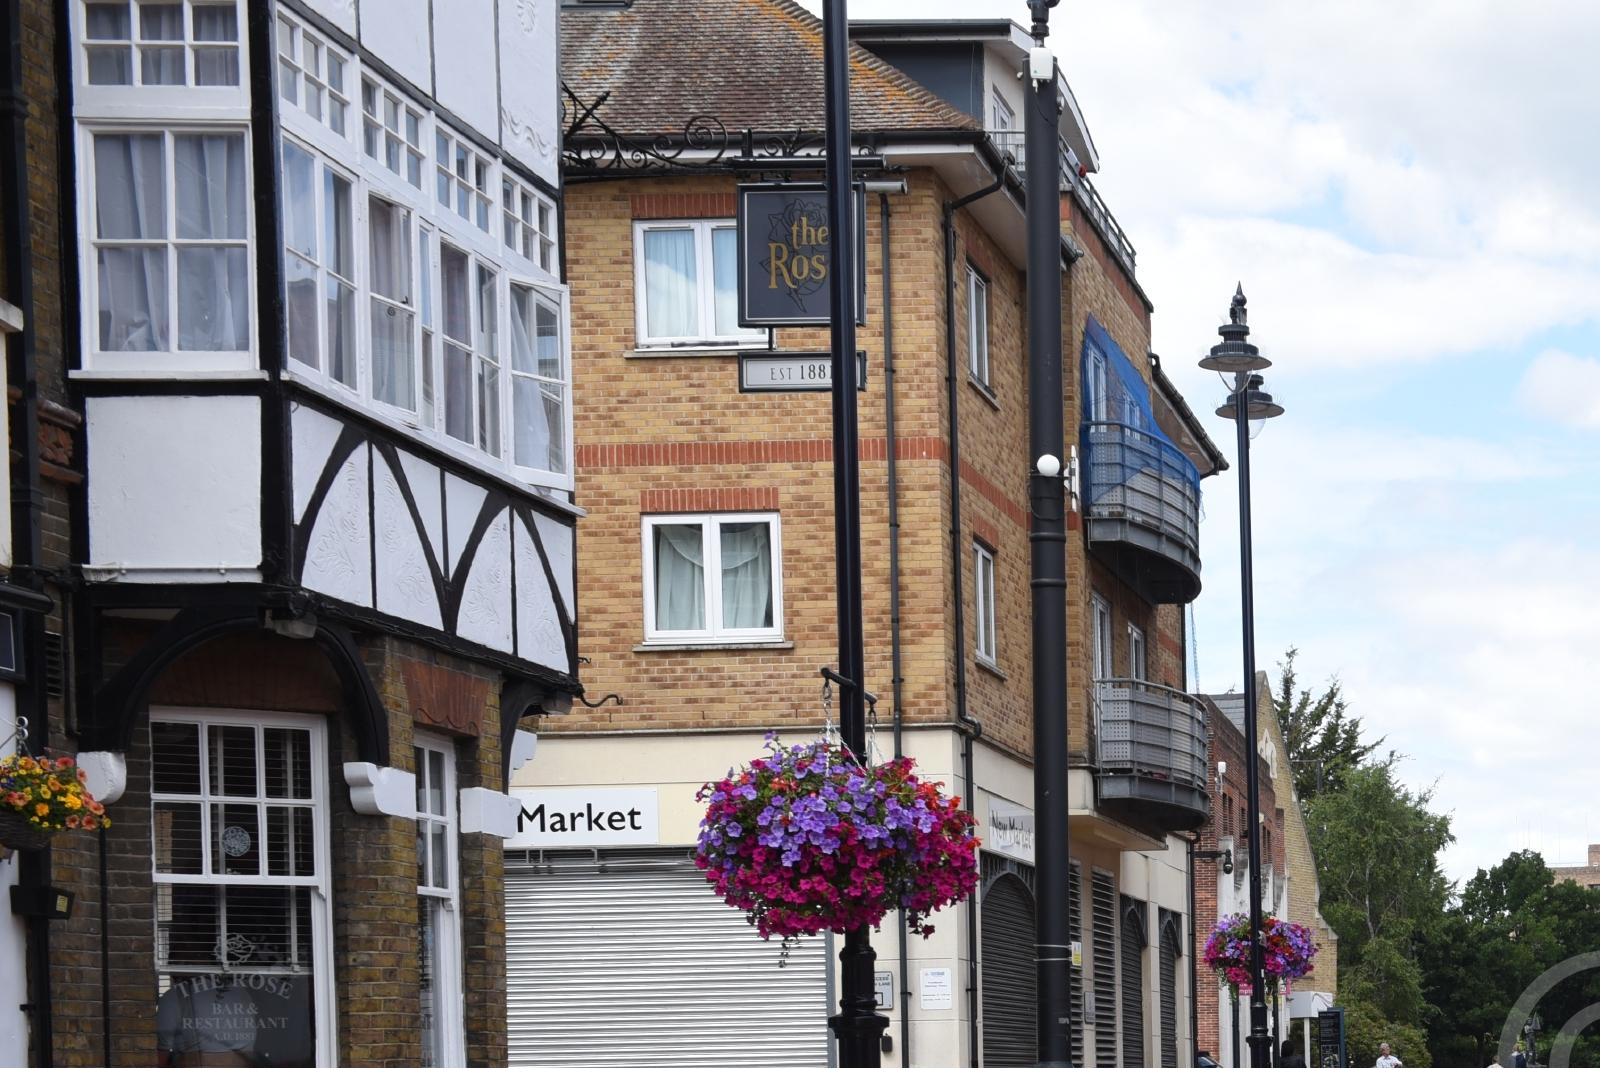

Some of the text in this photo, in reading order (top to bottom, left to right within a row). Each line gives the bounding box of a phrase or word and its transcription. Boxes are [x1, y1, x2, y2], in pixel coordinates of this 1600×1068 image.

[791, 216, 829, 250] the
[768, 242, 829, 289] Ros
[771, 367, 793, 380] EST
[516, 802, 642, 833] Market
[173, 973, 294, 1000] THE ROSE
[211, 1002, 258, 1015] BAR &
[182, 1017, 289, 1030] RESTAURANT
